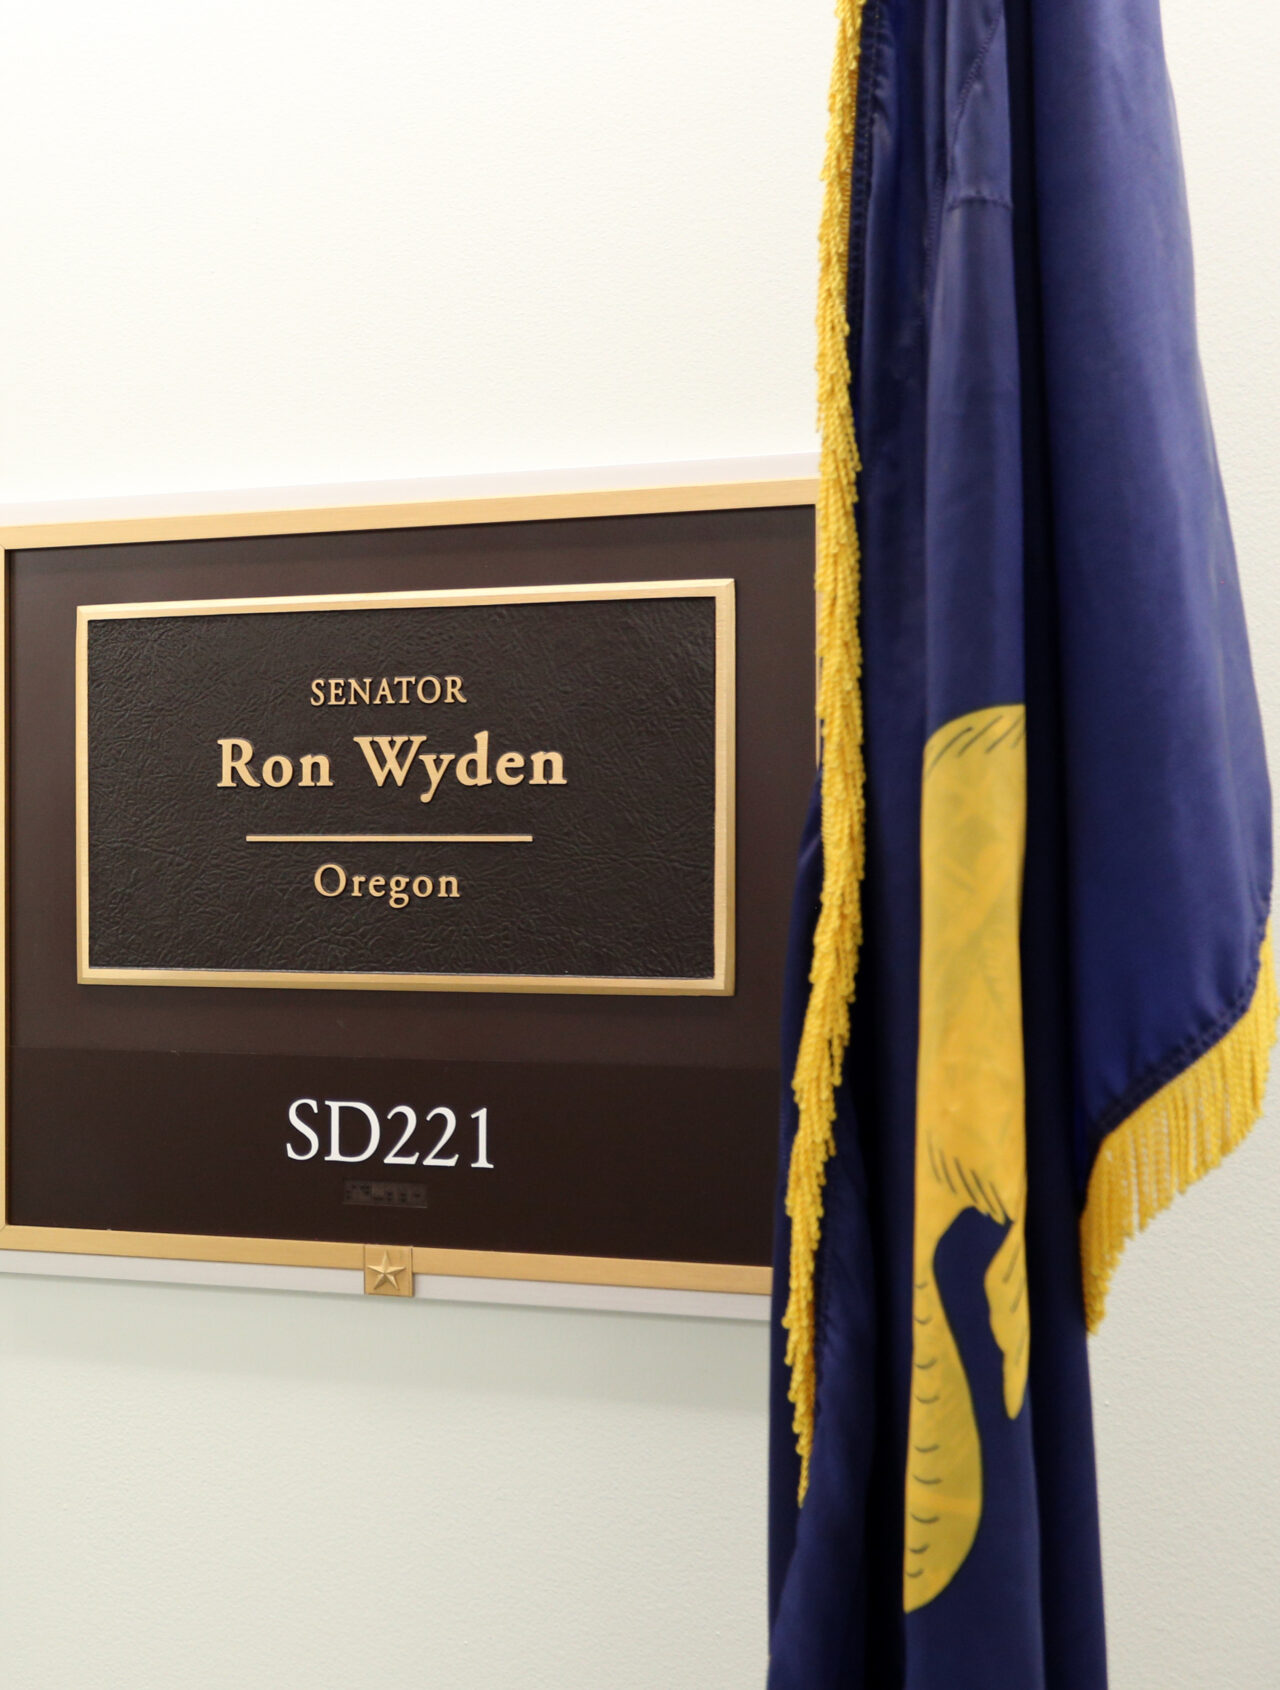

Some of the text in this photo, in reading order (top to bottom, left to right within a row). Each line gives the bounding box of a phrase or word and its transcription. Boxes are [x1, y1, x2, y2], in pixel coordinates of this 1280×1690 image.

[310, 675, 468, 706] SENATOR
[216, 729, 568, 803] Ron Wyden
[313, 863, 461, 909] Oregon
[286, 1098, 495, 1169] SD221
